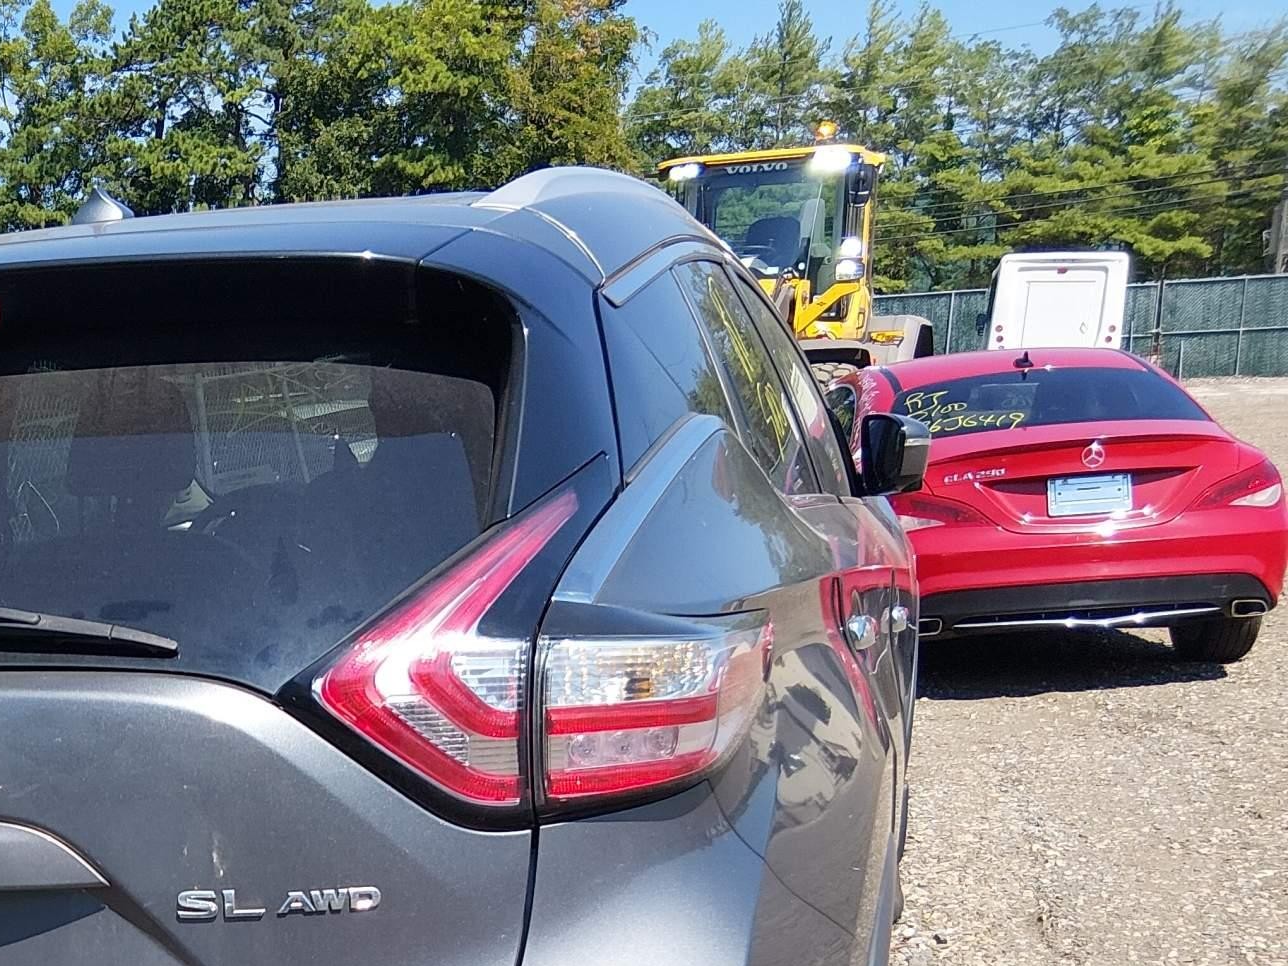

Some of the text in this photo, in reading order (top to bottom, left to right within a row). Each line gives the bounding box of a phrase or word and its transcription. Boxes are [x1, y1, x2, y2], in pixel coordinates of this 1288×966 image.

[725, 162, 788, 175] VOLVO
[920, 412, 1025, 433] 6J6419
[176, 886, 382, 920] SL AWD
